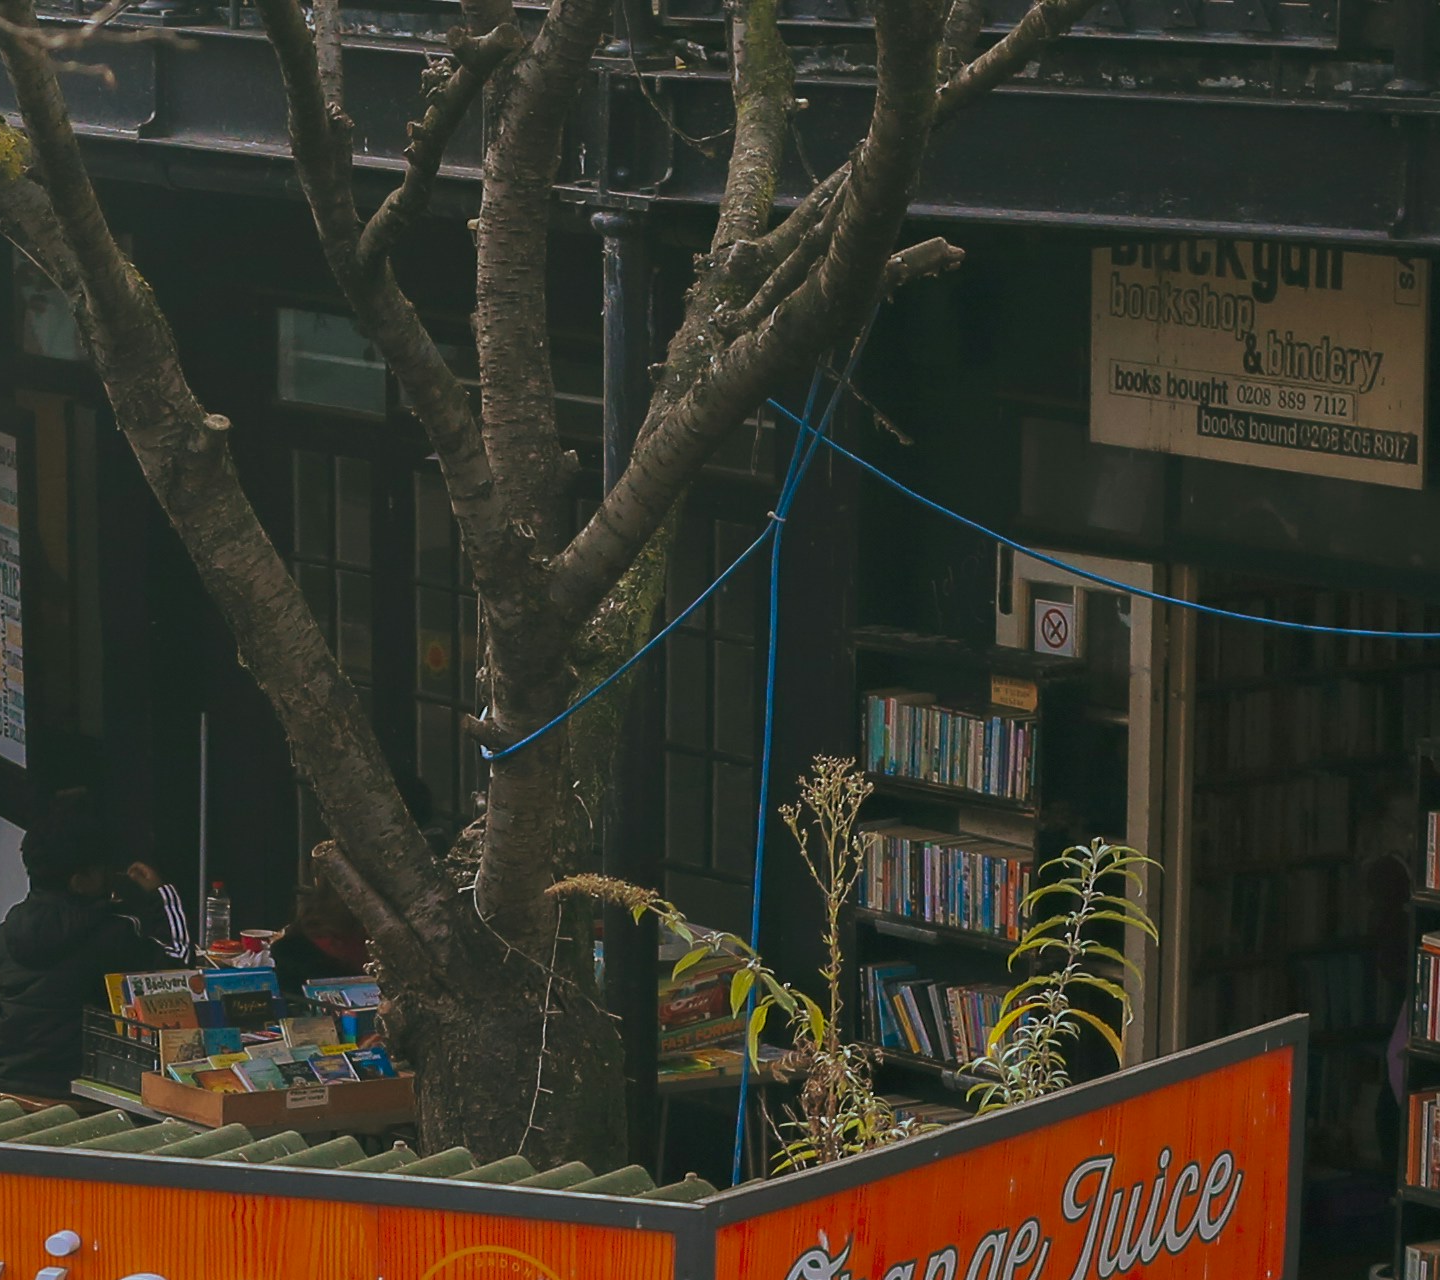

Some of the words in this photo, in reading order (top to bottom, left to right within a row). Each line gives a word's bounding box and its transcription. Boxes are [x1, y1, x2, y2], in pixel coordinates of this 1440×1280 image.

[1110, 271, 1255, 341] bookshop
[1242, 333, 1265, 375] &
[1266, 329, 1384, 394] bindery
[1114, 364, 1161, 396] books
[1166, 370, 1228, 408] bought
[1236, 384, 1271, 408] 0208
[1278, 386, 1306, 411] 889
[1313, 392, 1347, 418] 7112
[1201, 408, 1246, 440] books
[1248, 415, 1297, 447] bound
[145, 975, 188, 992] Backyard
